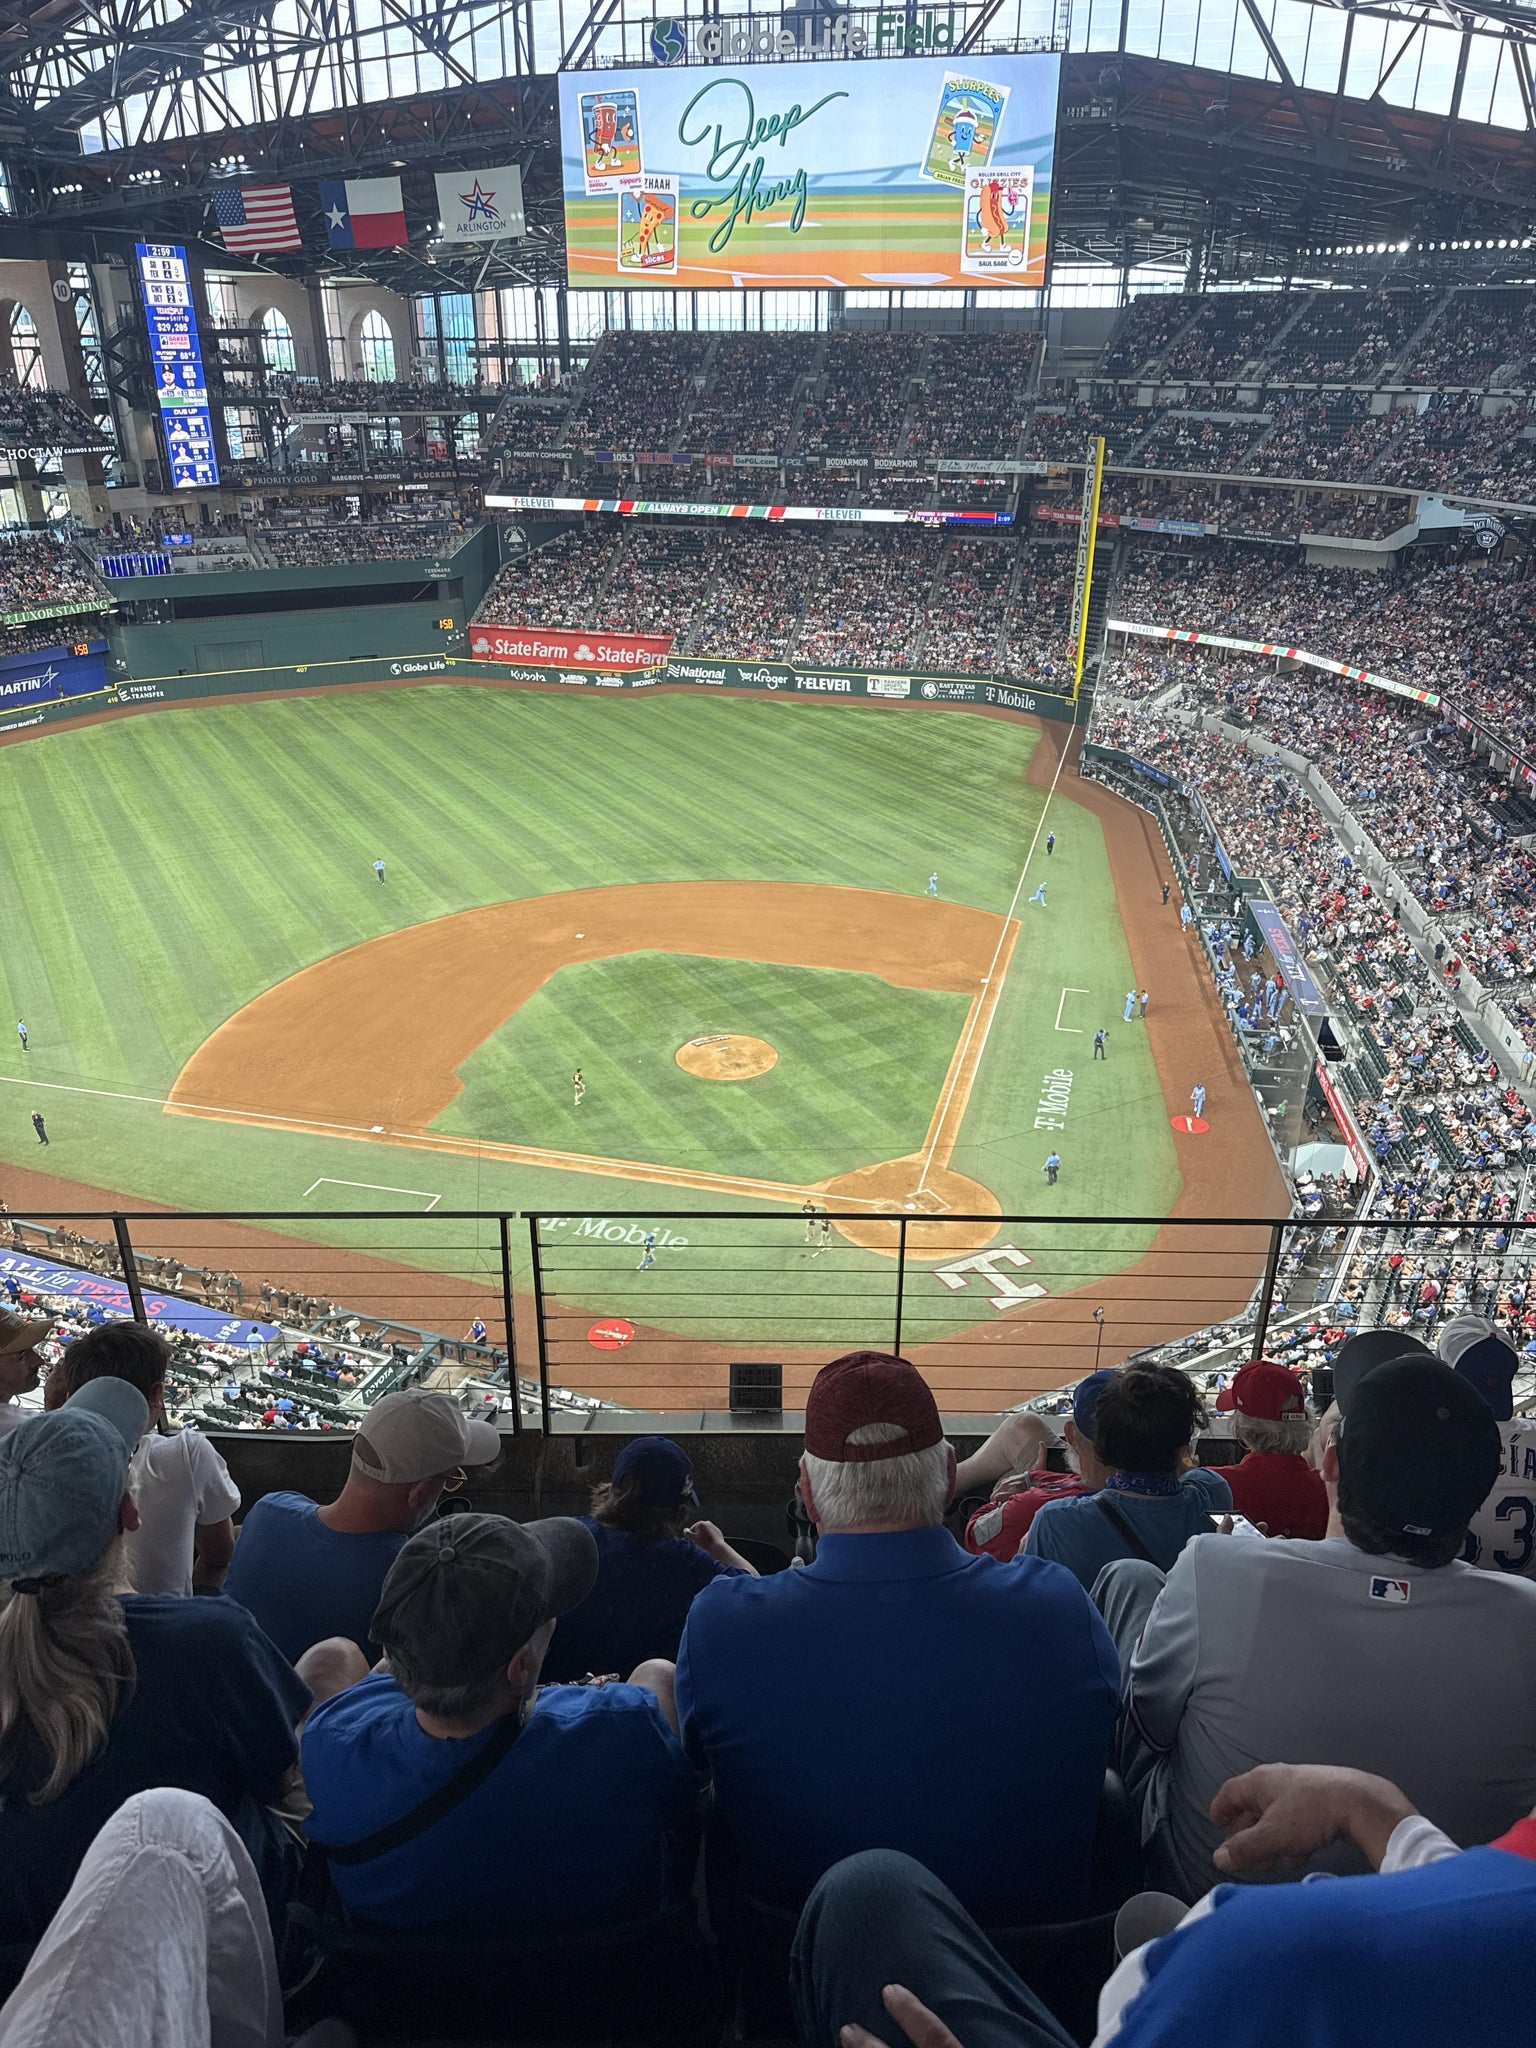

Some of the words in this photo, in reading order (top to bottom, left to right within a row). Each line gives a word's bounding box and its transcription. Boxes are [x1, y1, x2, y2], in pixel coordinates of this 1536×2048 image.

[696, 20, 796, 58] Globe
[803, 15, 867, 52] Life
[875, 10, 956, 50] Field
[948, 79, 1001, 104] SLURPEES
[678, 78, 849, 182] Deep
[456, 220, 507, 233] ARLINGTON
[151, 247, 171, 256] 2:59
[644, 254, 665, 265] slices
[55, 284, 67, 297] 10
[0, 446, 64, 461] CHOCTAW
[513, 451, 539, 459] PRIORITY
[540, 452, 573, 460] COMMERCE
[612, 453, 635, 462] 105.3
[713, 456, 731, 464] PGL
[735, 457, 776, 466] GoPGL.com
[785, 458, 804, 467] PGL
[826, 458, 869, 467] BODYARMOR
[874, 459, 918, 468] BODYARMOR
[939, 460, 963, 471] Blue
[965, 461, 992, 472] Mint
[294, 475, 317, 483] GOLD
[331, 474, 364, 482] HARGROVE
[374, 473, 401, 481] ROOFING
[413, 470, 457, 479] PLUCKERS
[648, 504, 688, 513] ALWAYS
[690, 504, 718, 514] OPEN
[1081, 468, 1094, 545] CHIKIN
[1078, 552, 1086, 577] IZ
[14, 608, 53, 622] LUXOR
[56, 599, 109, 616] STAFFING
[1072, 583, 1084, 635] FARE
[402, 663, 428, 673] Globe
[429, 661, 445, 671] Life
[510, 670, 547, 682] Kubota
[680, 667, 726, 680] National
[753, 668, 788, 690] Kroger
[130, 685, 157, 693] ENERGY
[870, 679, 880, 690] T
[131, 690, 165, 699] TRANSFER
[998, 689, 1036, 710] Mobile
[1036, 1068, 1074, 1117] Mobile
[572, 1217, 690, 1252] Mobile
[0, 1256, 46, 1285] ALL
[42, 1269, 79, 1290] for
[364, 1366, 395, 1398] TOYOTA
